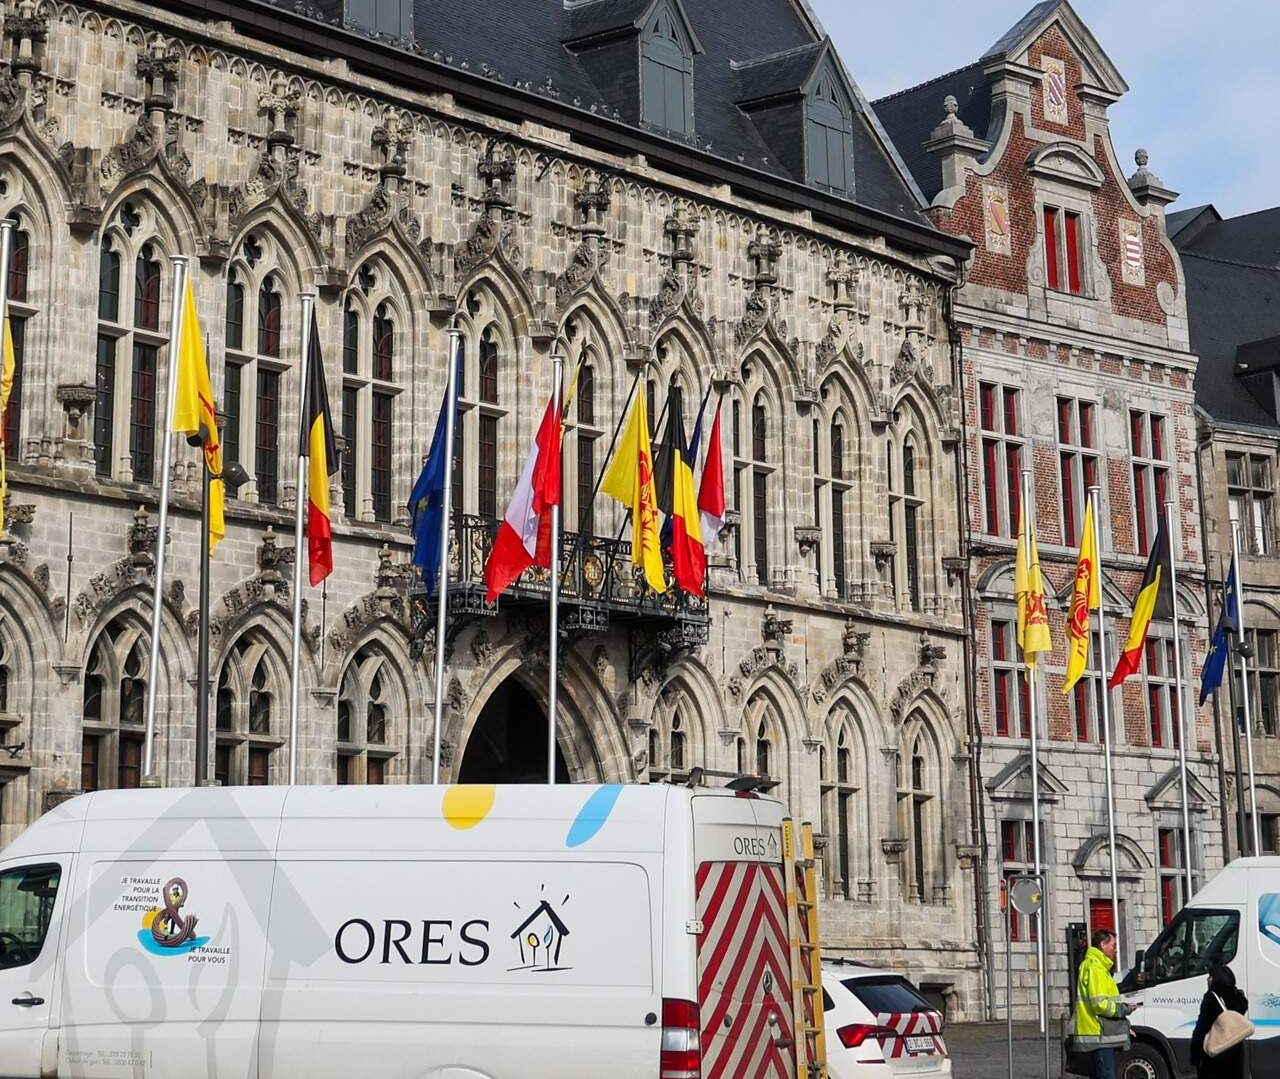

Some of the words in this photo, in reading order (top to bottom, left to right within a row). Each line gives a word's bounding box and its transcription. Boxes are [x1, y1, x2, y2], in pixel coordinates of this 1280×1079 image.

[734, 837, 766, 856] ORES
[334, 918, 490, 966] ORES
[208, 956, 226, 964] VOUS
[1152, 997, 1201, 1006] www.aquav
